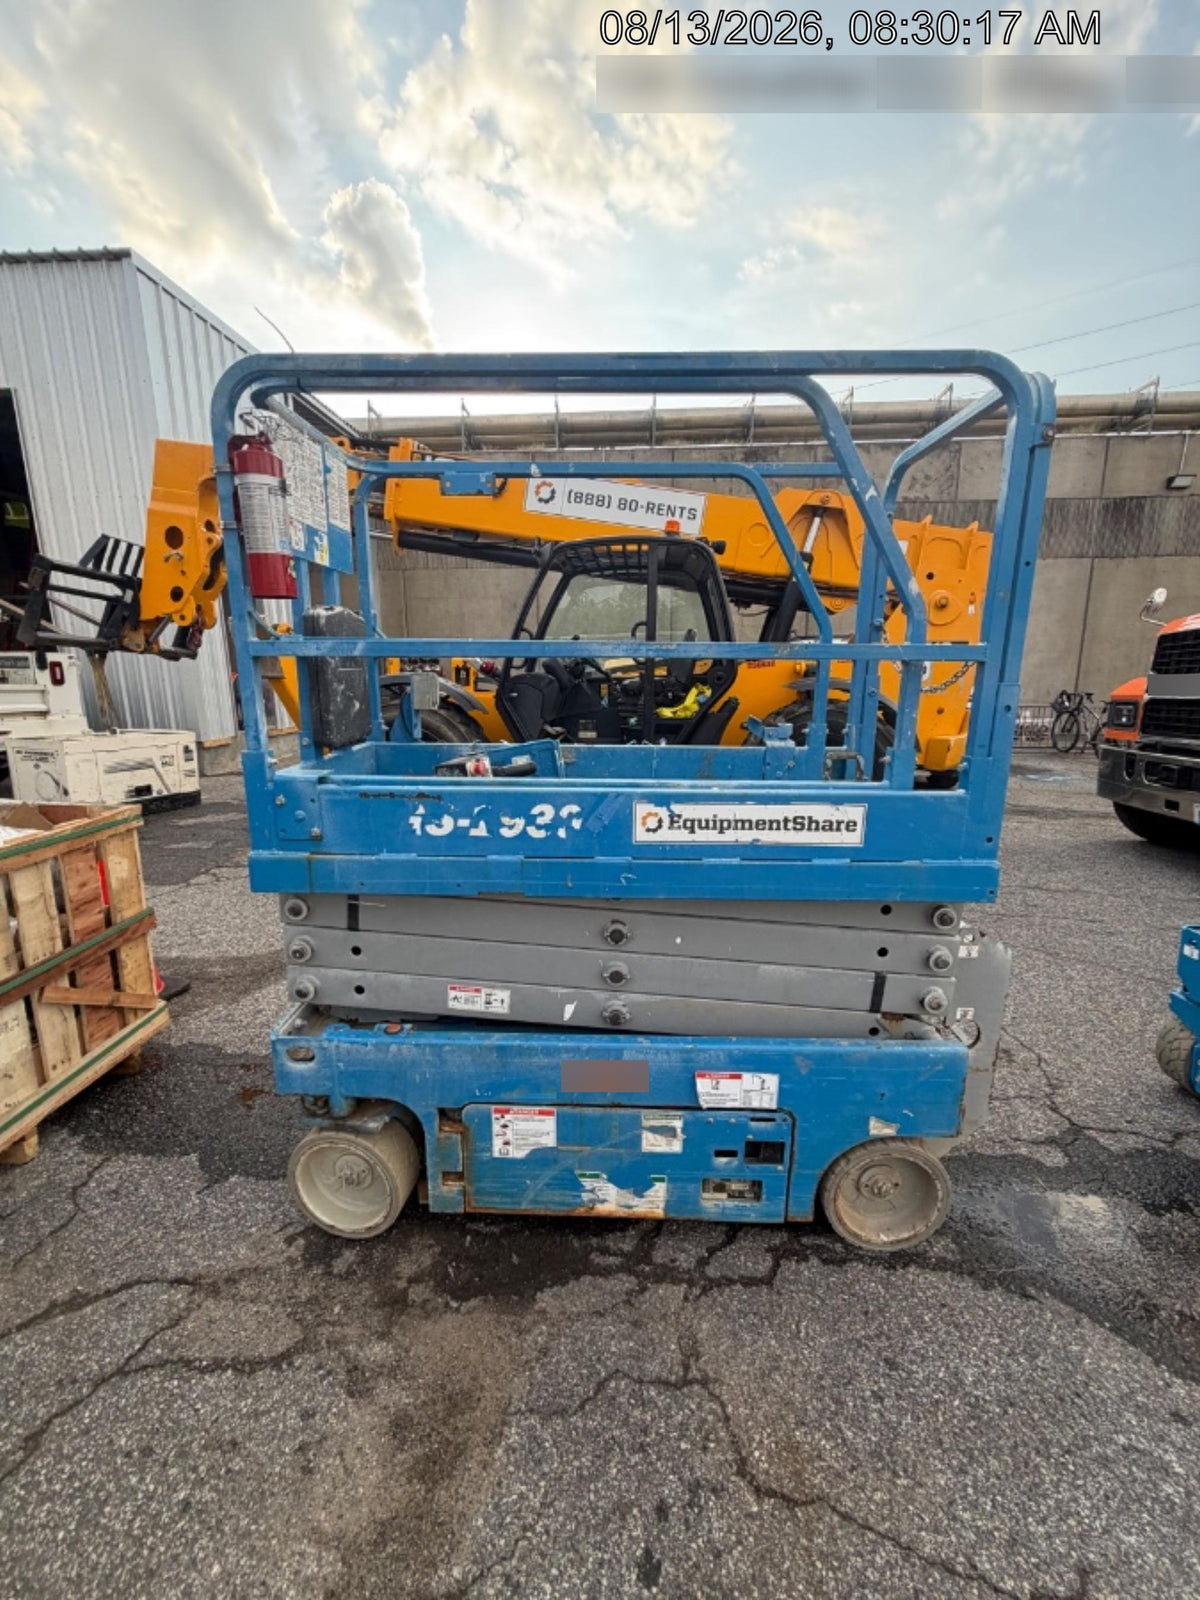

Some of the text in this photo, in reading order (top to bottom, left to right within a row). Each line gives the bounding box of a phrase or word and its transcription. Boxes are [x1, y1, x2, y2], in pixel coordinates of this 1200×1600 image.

[567, 488, 698, 521] (888) 80-RENTS
[667, 813, 858, 835] EquipmentShare
